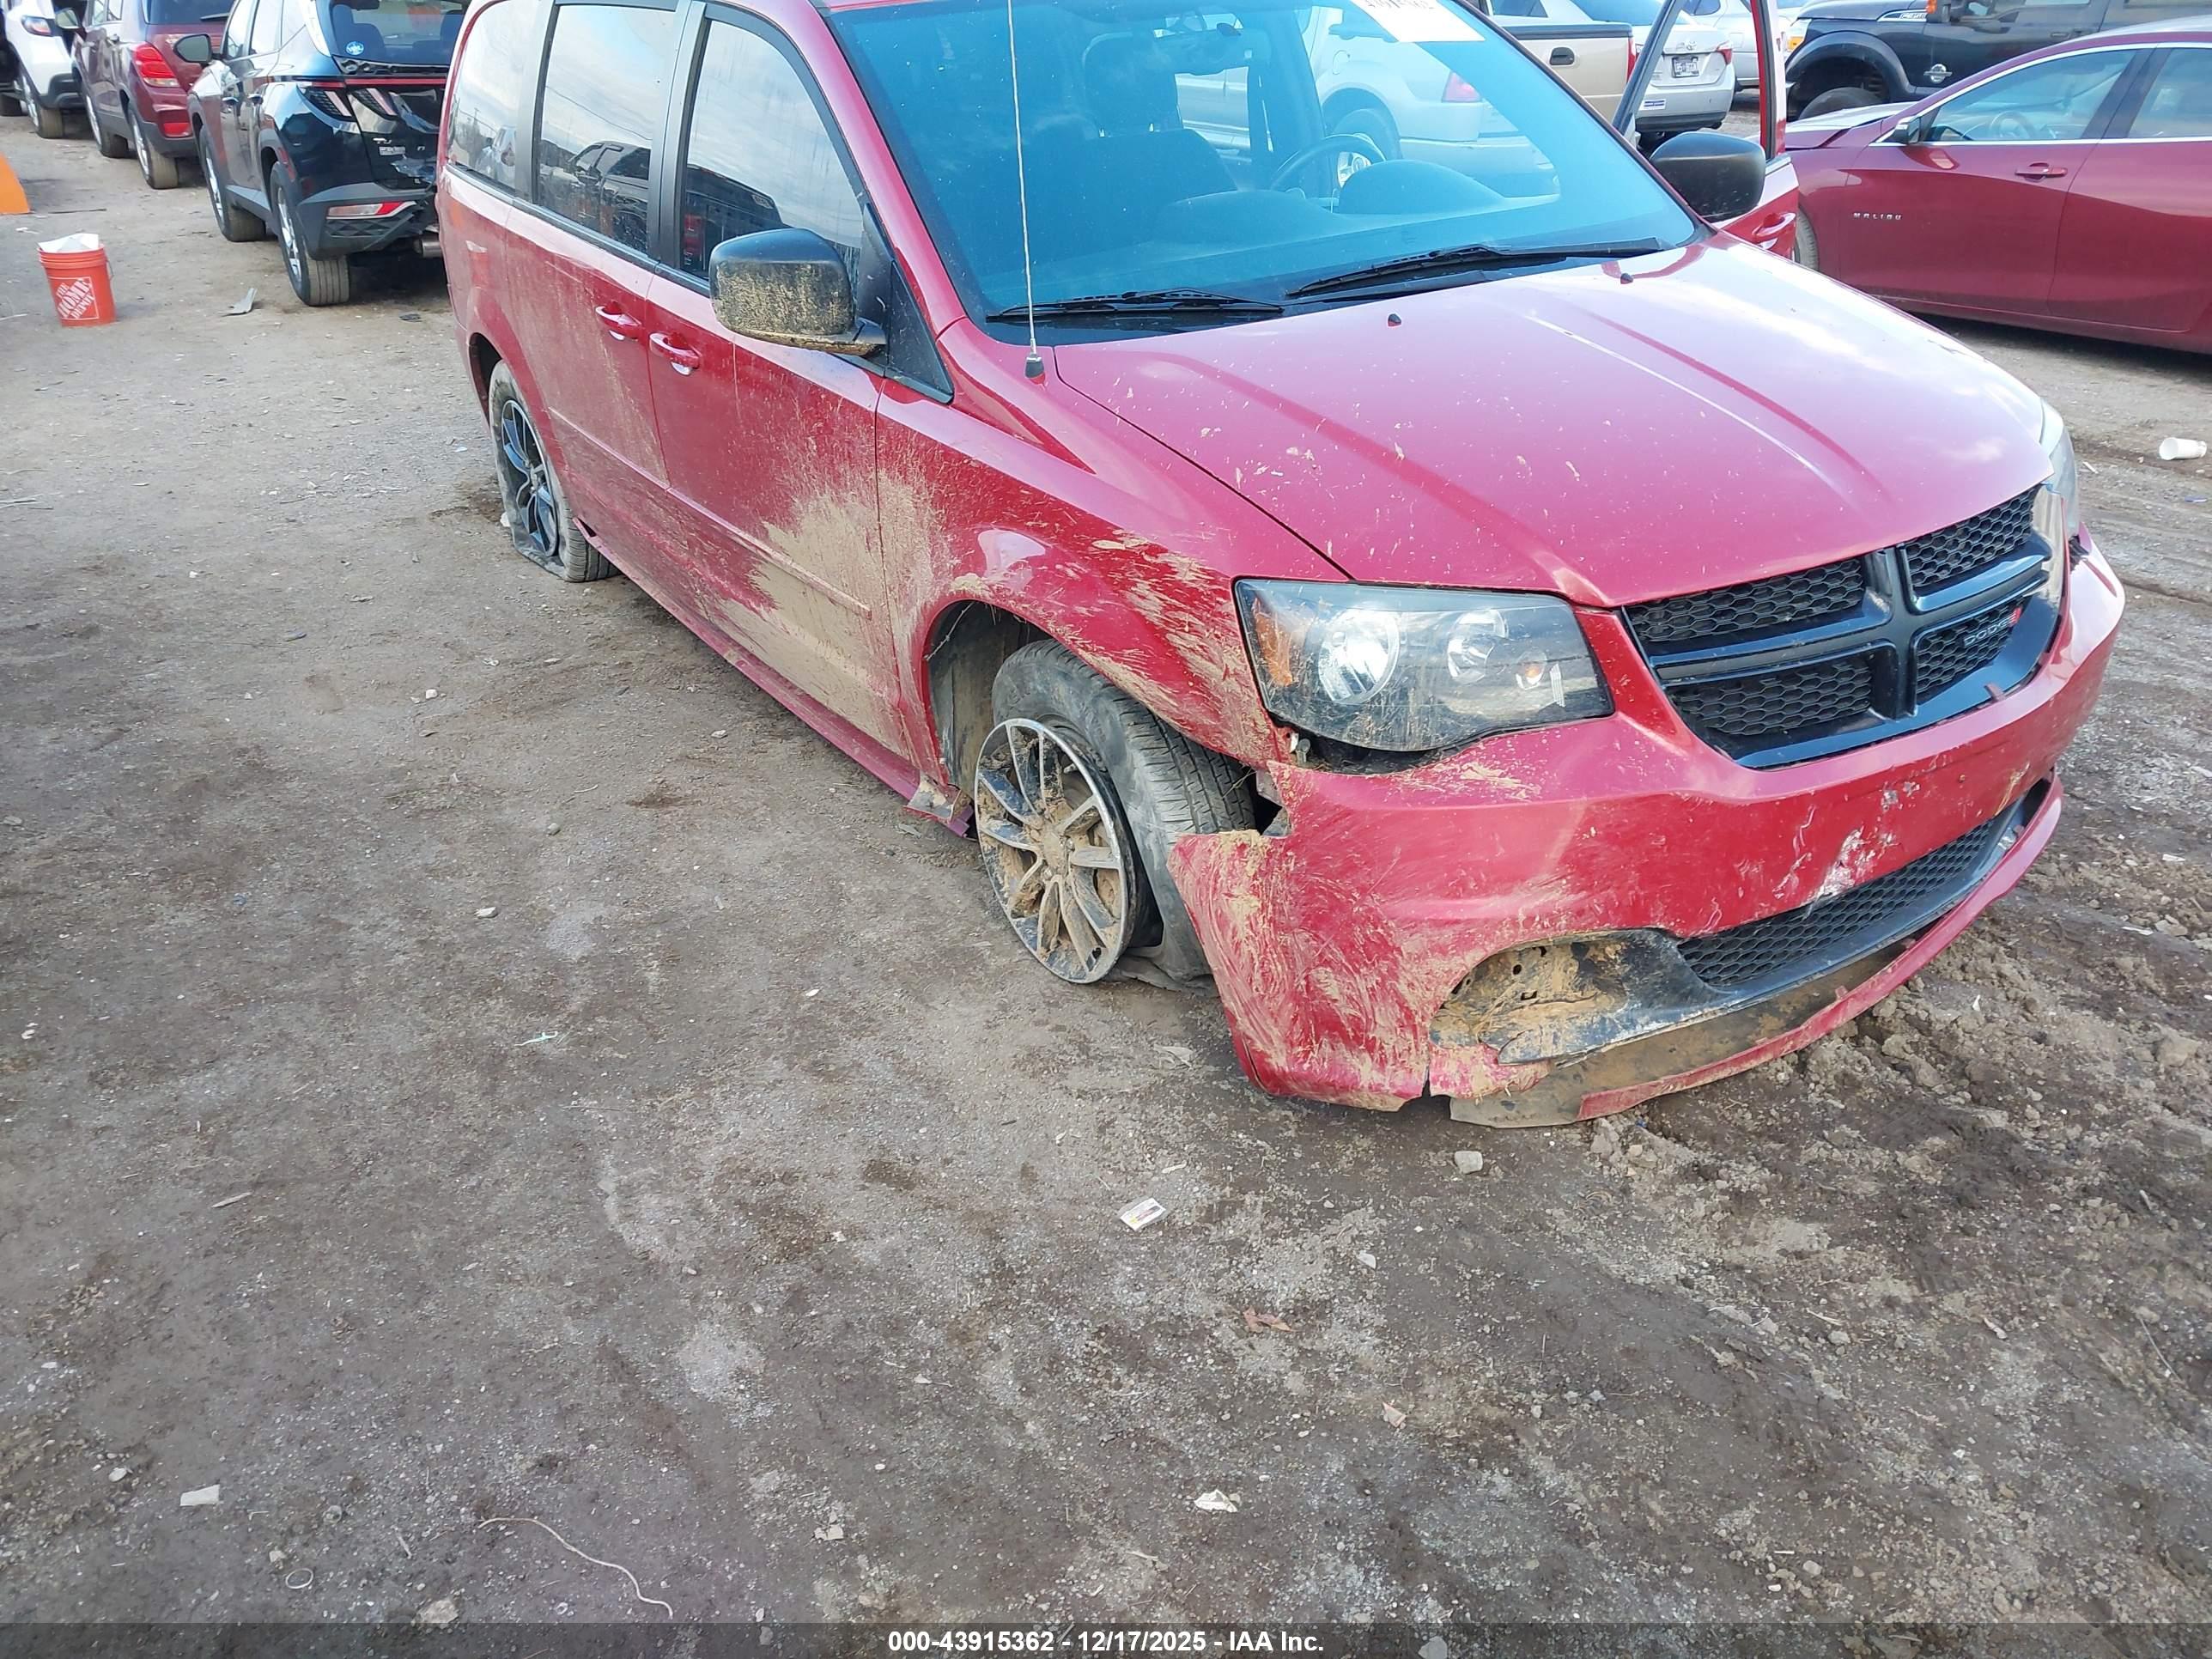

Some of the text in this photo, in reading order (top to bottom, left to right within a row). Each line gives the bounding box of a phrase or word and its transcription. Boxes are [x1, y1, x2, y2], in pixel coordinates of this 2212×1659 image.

[1853, 212, 1903, 221] MALIBU
[58, 279, 92, 318] HOME
[70, 294, 94, 319] DEPOT
